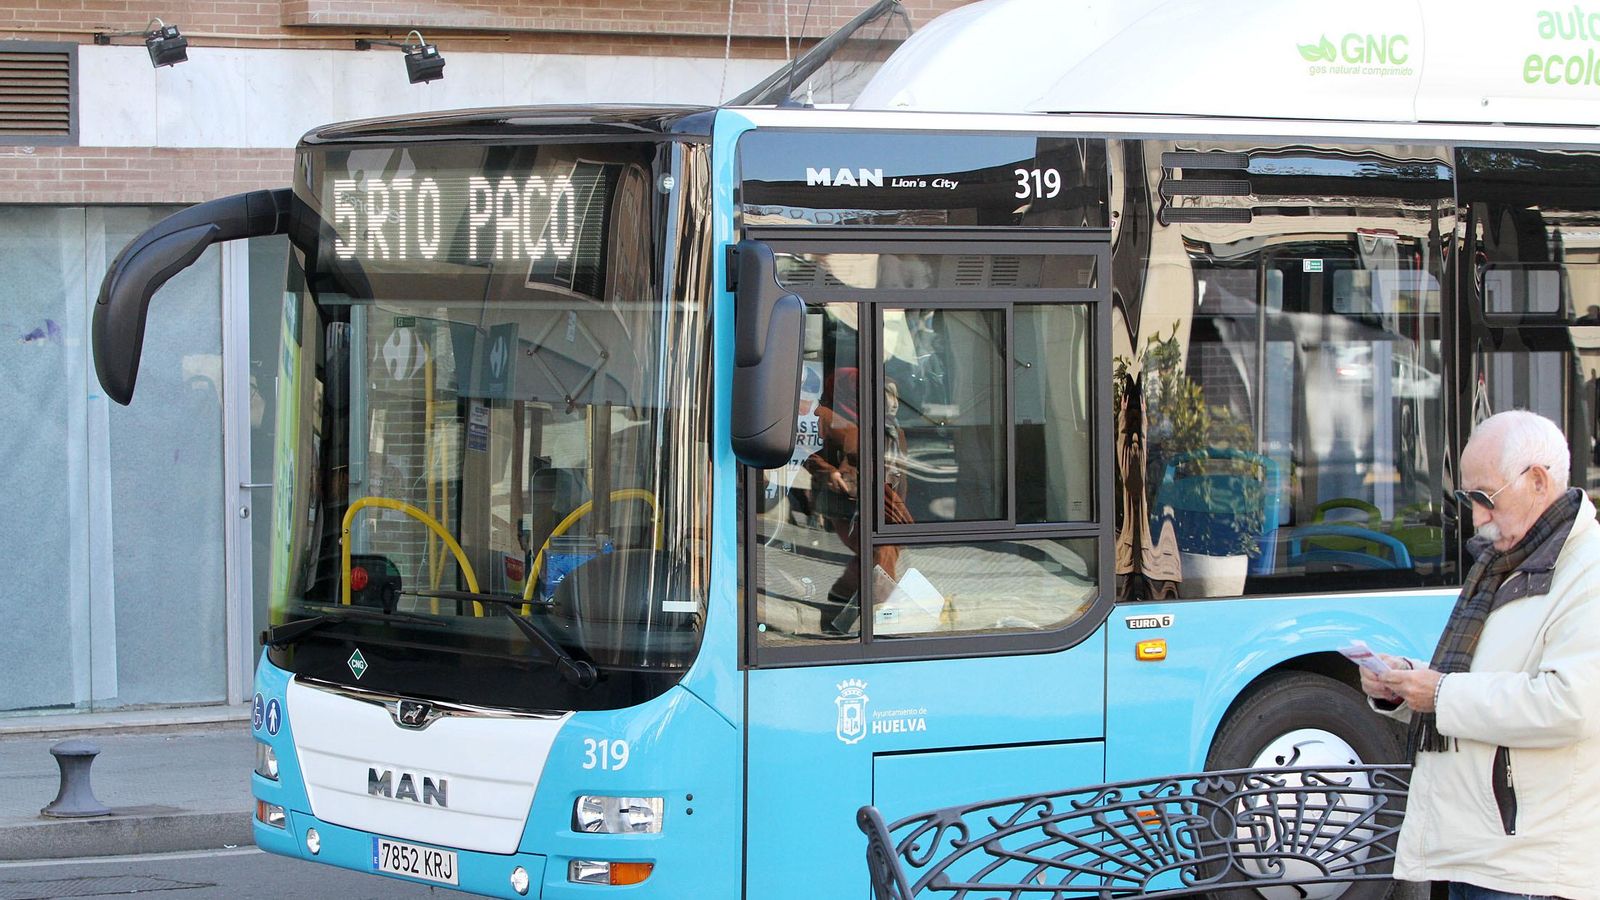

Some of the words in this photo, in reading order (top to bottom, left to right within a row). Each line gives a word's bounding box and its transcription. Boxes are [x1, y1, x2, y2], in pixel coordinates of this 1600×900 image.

[1341, 32, 1409, 65] GNC
[1309, 65, 1327, 76] gas
[1329, 64, 1360, 75] natural
[1361, 66, 1414, 78] comprimido
[806, 167, 884, 187] MAN
[892, 177, 926, 188] Lion's
[931, 178, 959, 190] City
[1014, 168, 1061, 199] 319
[468, 175, 575, 260] PACO
[1129, 618, 1157, 629] EURO
[1162, 616, 1171, 627] 6
[351, 658, 364, 670] CNG
[872, 708, 917, 719] Ayuntamiento
[918, 706, 927, 715] de
[872, 718, 927, 734] HUELVA
[582, 738, 630, 771] 319
[367, 766, 449, 808] MAN
[382, 842, 420, 874] 7852
[424, 849, 453, 880] KRJ
